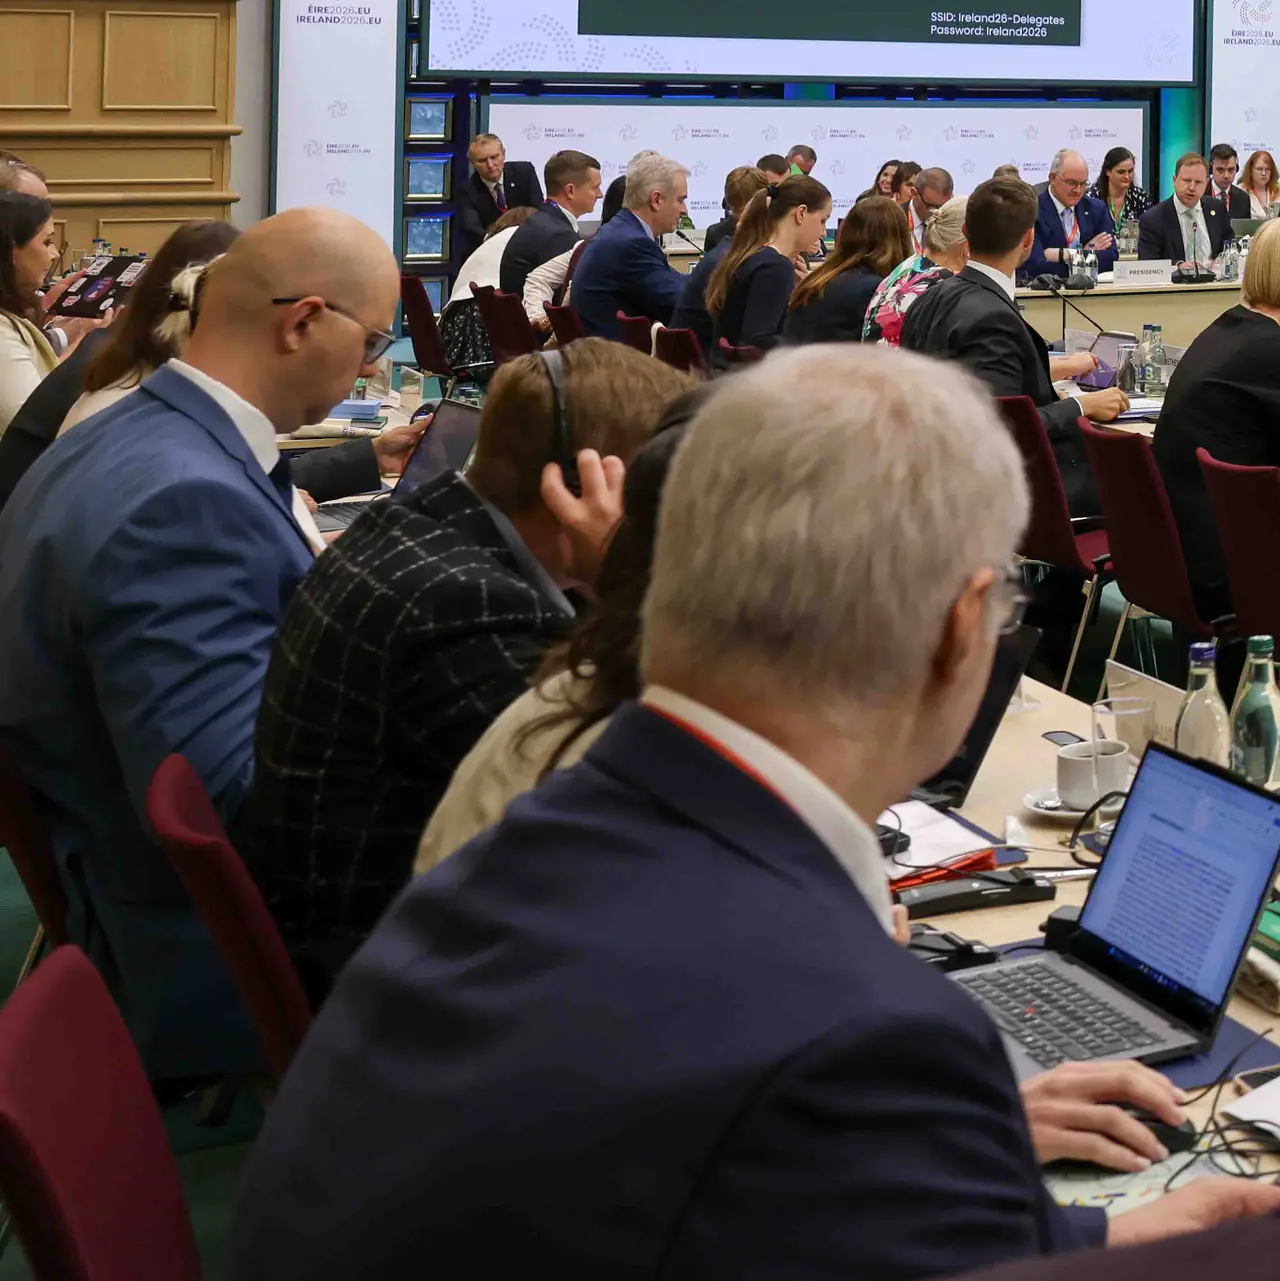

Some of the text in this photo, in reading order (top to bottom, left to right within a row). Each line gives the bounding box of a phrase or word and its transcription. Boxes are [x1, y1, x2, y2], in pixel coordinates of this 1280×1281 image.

[308, 4, 371, 15] ÉIRE2026.EU
[296, 15, 382, 25] IRELAND2026.EU
[930, 12, 1065, 27] SSID: Ireland26-Delegates
[930, 25, 1047, 37] Password: Ireland2026
[1231, 29, 1274, 38] ÉIRE2026.EU
[1129, 268, 1165, 276] PRESIDENCY
